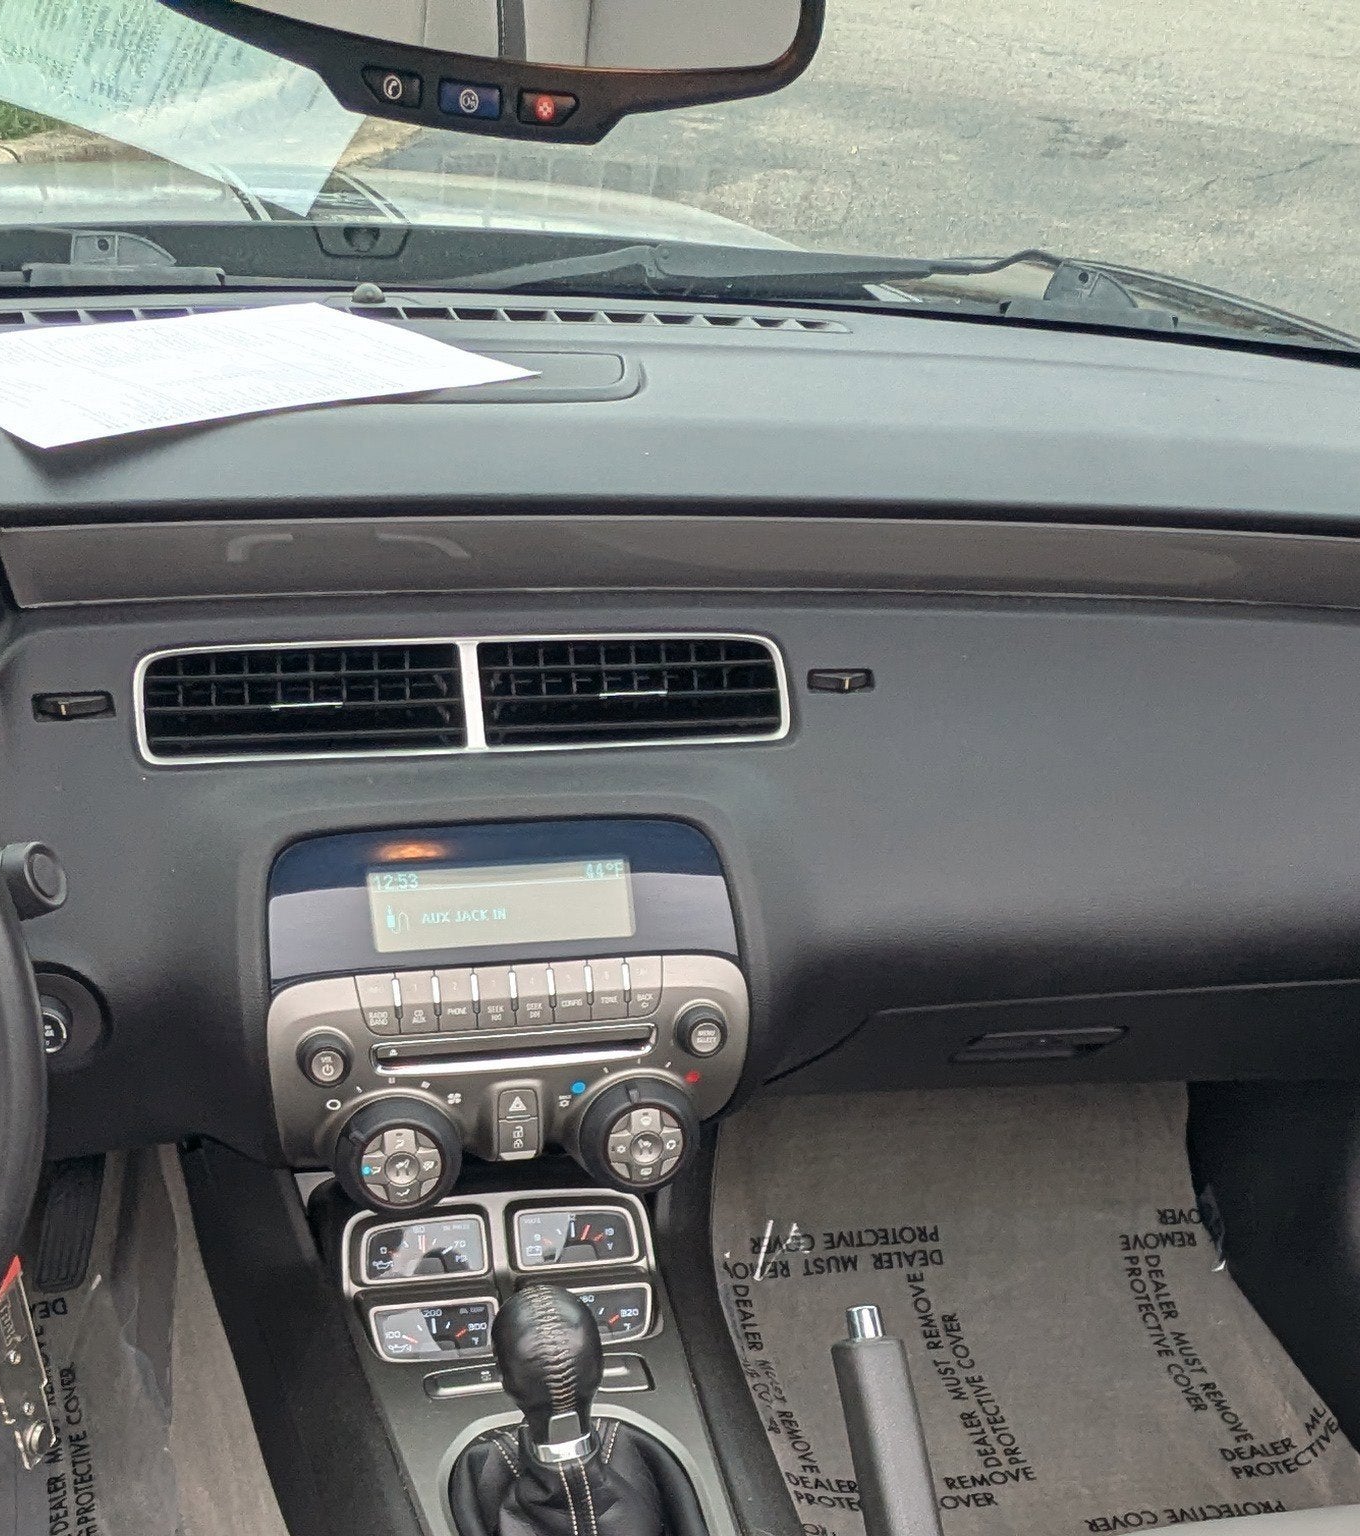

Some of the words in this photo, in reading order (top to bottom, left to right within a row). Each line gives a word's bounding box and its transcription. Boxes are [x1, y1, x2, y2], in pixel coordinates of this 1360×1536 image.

[373, 873, 419, 891] 12:53
[422, 911, 451, 925] AUX
[454, 909, 488, 923] JACK
[492, 908, 507, 921] IN
[487, 1005, 504, 1013] SEEK
[561, 998, 583, 1008] CONFIG
[636, 993, 654, 1002] BACK
[447, 1007, 467, 1015] PHONE
[824, 1225, 940, 1250] PROTECTIVE
[1119, 1231, 1197, 1251] REMOVE
[803, 1254, 858, 1276] MUST
[872, 1249, 944, 1271] DEALER
[422, 1309, 443, 1318] 200
[907, 1271, 943, 1350] REMOVE
[941, 1312, 976, 1371] COVER
[1124, 1254, 1174, 1359] PROTECTIVE
[1167, 1363, 1208, 1413] COVER
[1145, 1254, 1179, 1320] DEALER
[1170, 1330, 1207, 1375] MUST
[1199, 1381, 1254, 1444] REMOVE
[733, 1284, 764, 1351] DEALER
[777, 1410, 822, 1475] REMOVE
[935, 1358, 970, 1403] MUST
[964, 1376, 1028, 1468] PROTECTIVE
[959, 1411, 1000, 1469] DEALER
[1219, 1437, 1297, 1462] DEALER
[1231, 1418, 1340, 1480] PROTECTIVE
[68, 1430, 98, 1527] PROTECTIVE
[785, 1471, 859, 1494] DEALER
[943, 1465, 1038, 1491] REMOVE
[46, 1472, 70, 1536] DEALER
[1167, 1500, 1288, 1523] PROTECTIVE
[1084, 1510, 1158, 1532] COVER
